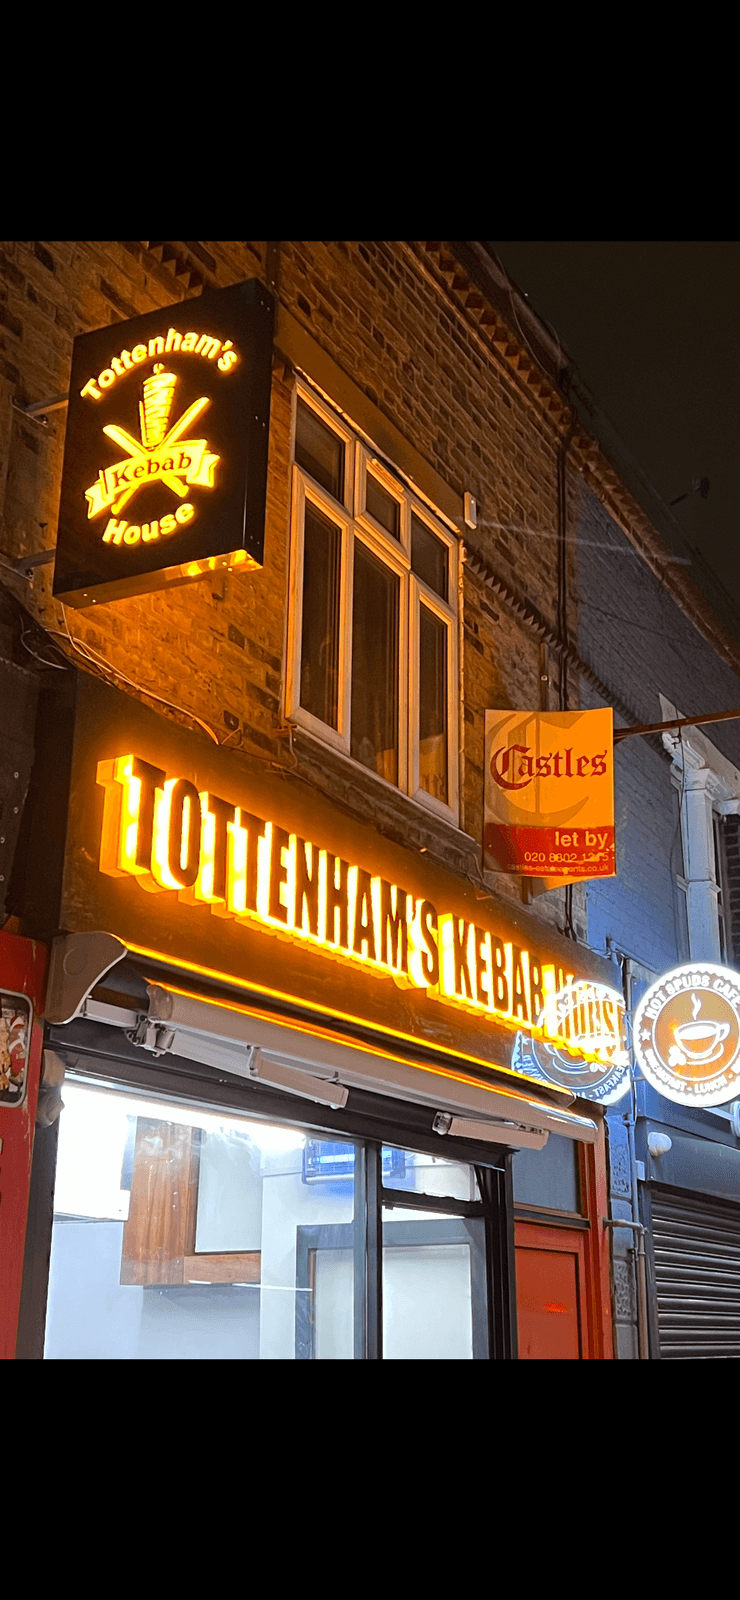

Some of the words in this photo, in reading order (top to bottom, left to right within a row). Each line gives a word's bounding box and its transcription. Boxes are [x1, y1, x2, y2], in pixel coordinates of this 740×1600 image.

[80, 328, 239, 401] Tottenham's
[111, 451, 192, 490] Kebab
[102, 503, 196, 546] House
[490, 744, 608, 791] Castles
[524, 851, 546, 862] 020
[582, 852, 609, 862] 125
[555, 831, 579, 847] let
[585, 830, 608, 850] by
[113, 754, 440, 988] TOTTENHAM'S
[439, 912, 543, 1026] KEBAB
[644, 990, 667, 1020] HOT
[665, 974, 710, 996] SPUDS
